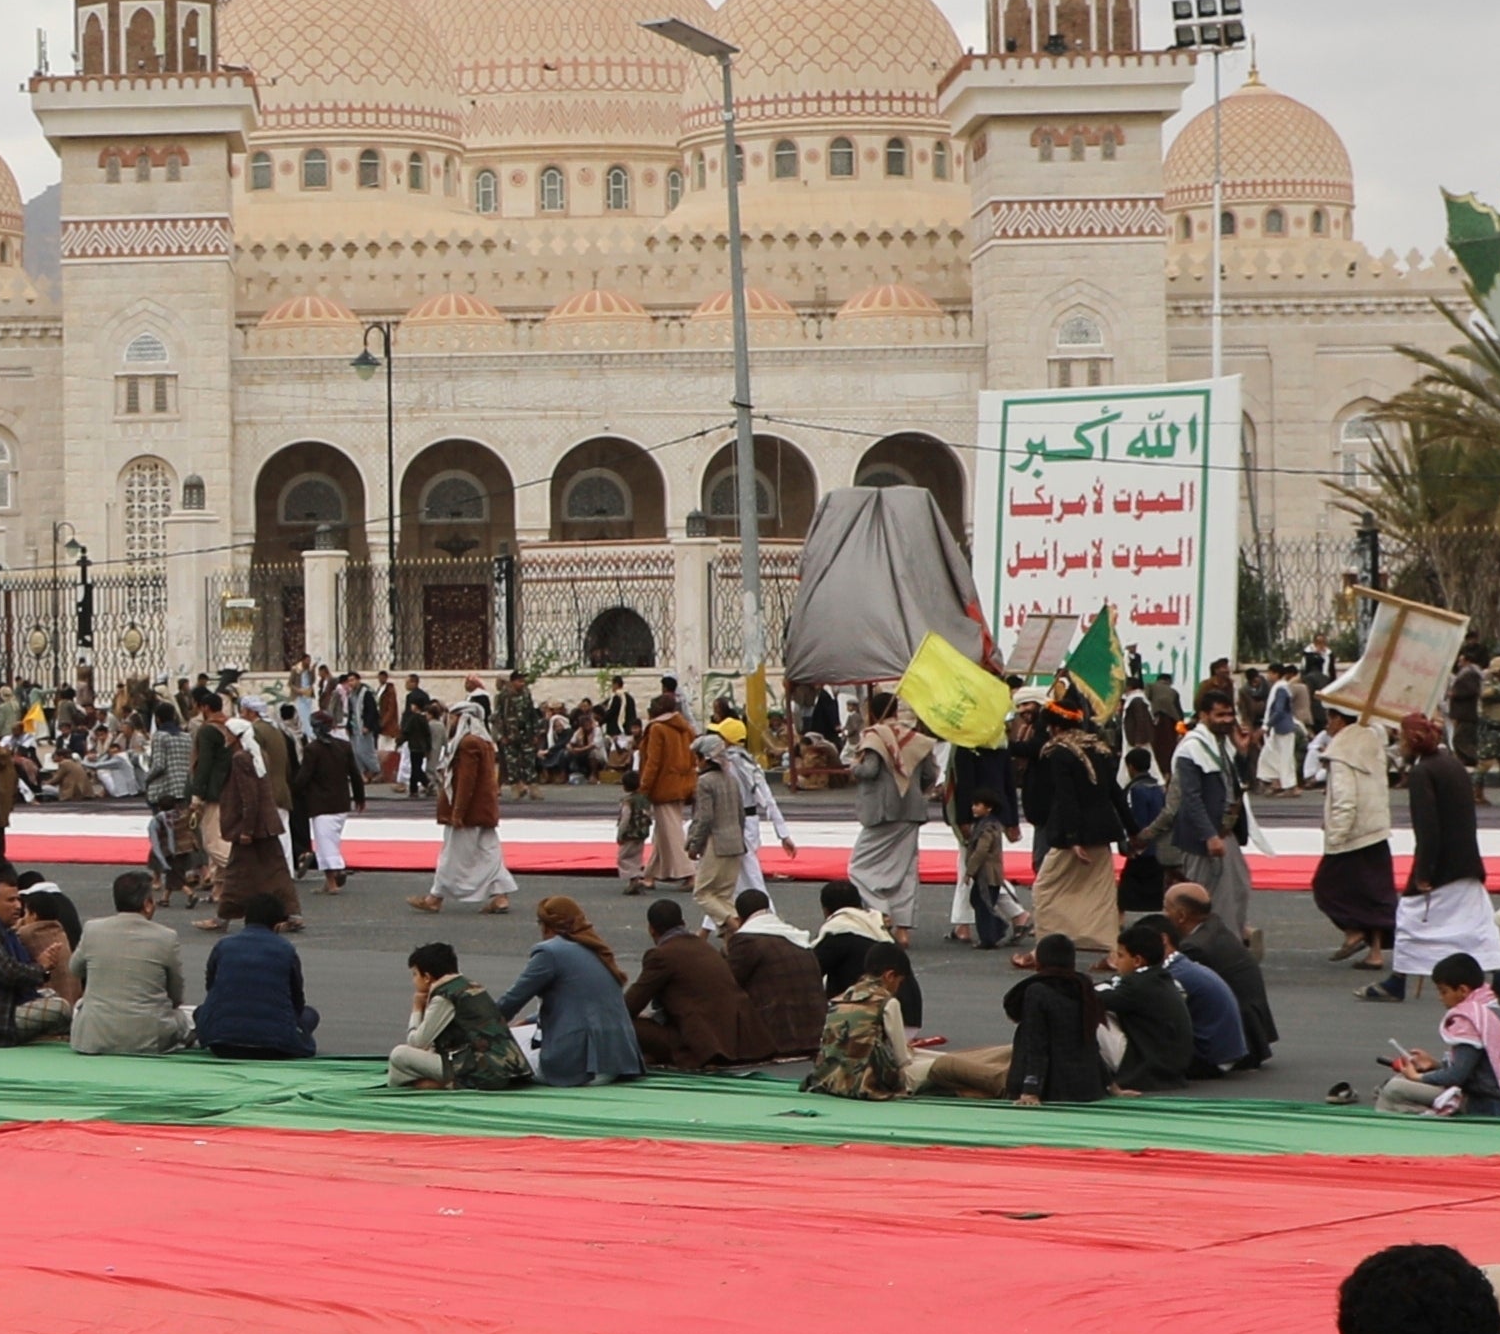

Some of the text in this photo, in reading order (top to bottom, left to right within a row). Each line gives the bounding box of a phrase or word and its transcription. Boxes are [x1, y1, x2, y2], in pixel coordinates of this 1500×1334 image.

[1009, 405, 1123, 479] أكبر
[1008, 476, 1195, 523] الموت لأمريكا
[1006, 536, 1194, 579] الموت لإسرائيل
[1130, 594, 1191, 627] اللعنة
